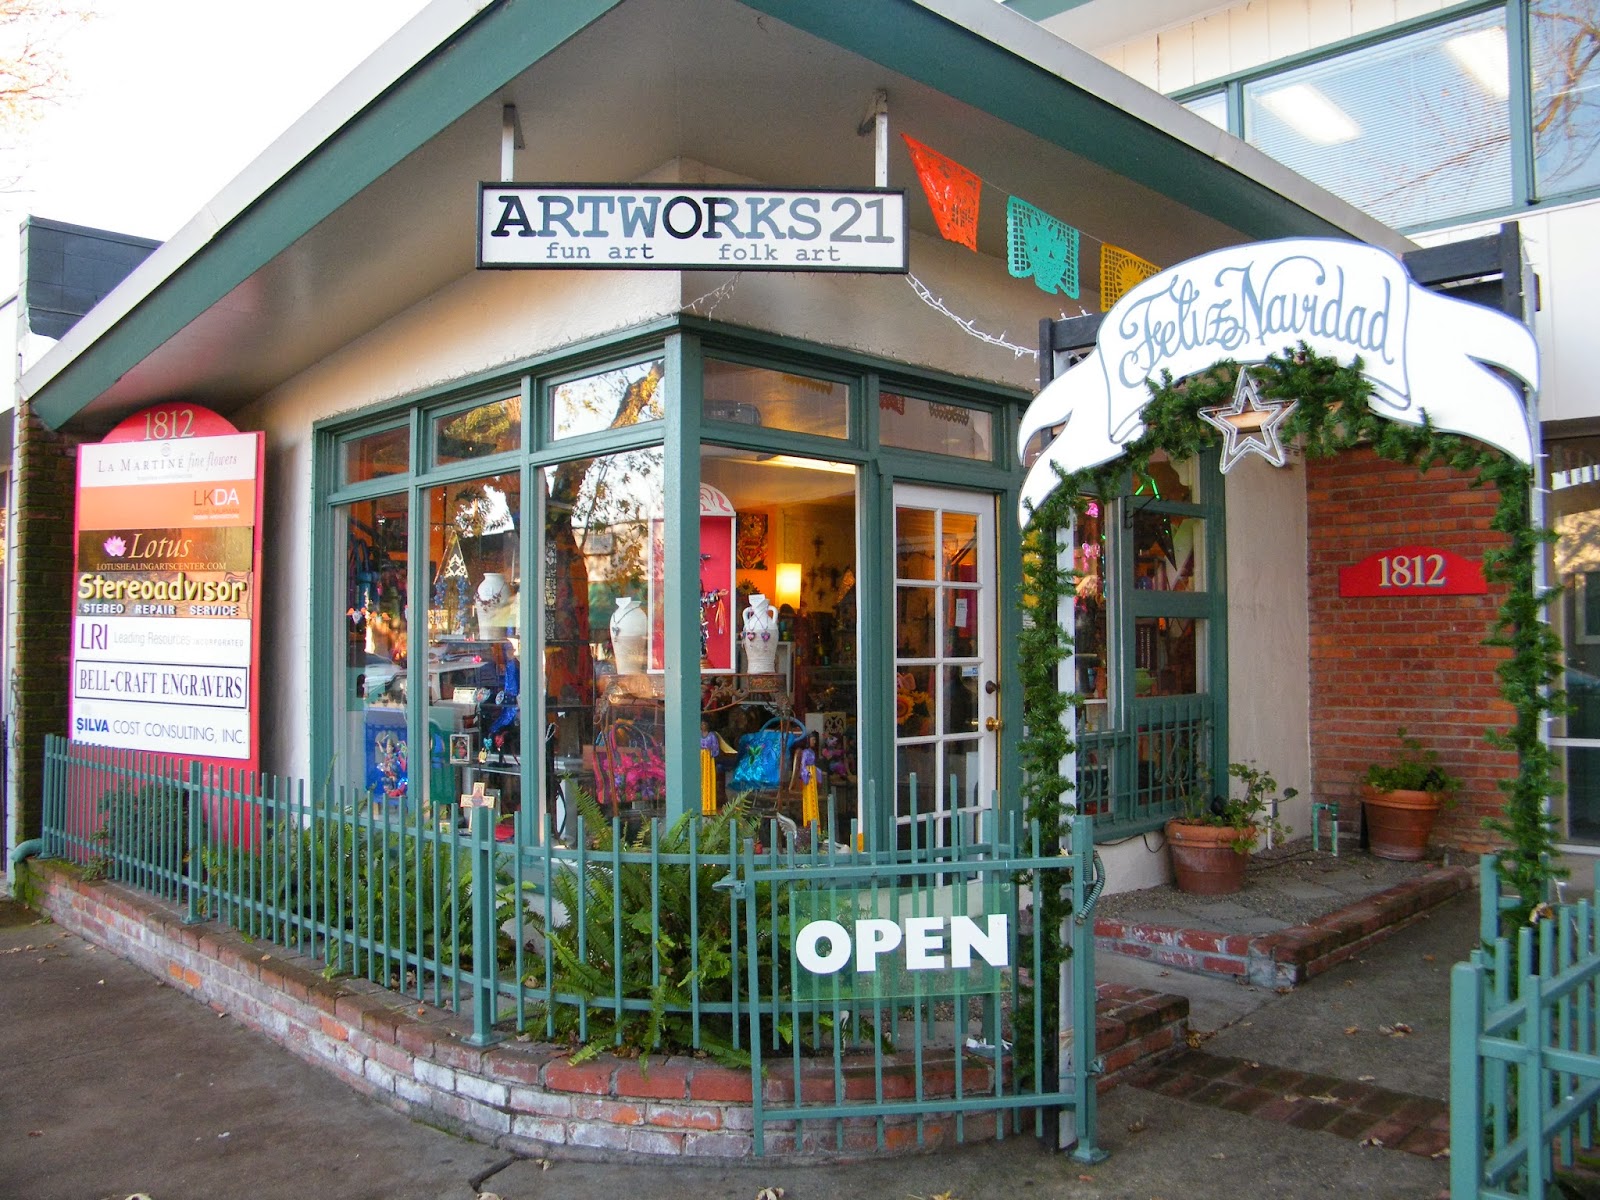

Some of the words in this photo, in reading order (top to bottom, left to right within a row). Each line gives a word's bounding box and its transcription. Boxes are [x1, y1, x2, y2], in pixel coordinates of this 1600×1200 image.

[546, 242, 591, 259] fun
[608, 243, 655, 260] art
[718, 243, 779, 261] folk
[795, 246, 841, 262] art
[1119, 274, 1250, 389] Feliz
[1215, 255, 1395, 366] Navidad
[143, 409, 195, 441] 1812
[98, 460, 115, 473] LA
[187, 451, 204, 472] fine
[206, 451, 238, 471] flowers
[194, 488, 240, 506] LKDA
[127, 532, 193, 559] Lotus
[96, 562, 227, 571] LOTUSHEALINGARTSCENTER.COM
[1378, 554, 1446, 588] 1812
[77, 571, 246, 602] Stereoadvisor
[83, 603, 125, 615] STEREO
[134, 604, 176, 616] REPAIR
[189, 604, 238, 616] SERVICE
[80, 623, 108, 650] LRI
[113, 631, 145, 646] Leading
[147, 632, 191, 646] Resources
[80, 669, 157, 693] BELL-CRAFT
[162, 673, 242, 699] ENGRAVERS
[76, 717, 110, 733] SILVA
[112, 719, 141, 735] COST
[144, 722, 218, 744] CONSULTING,
[222, 729, 246, 744] INC.
[795, 913, 1009, 975] OPEN
